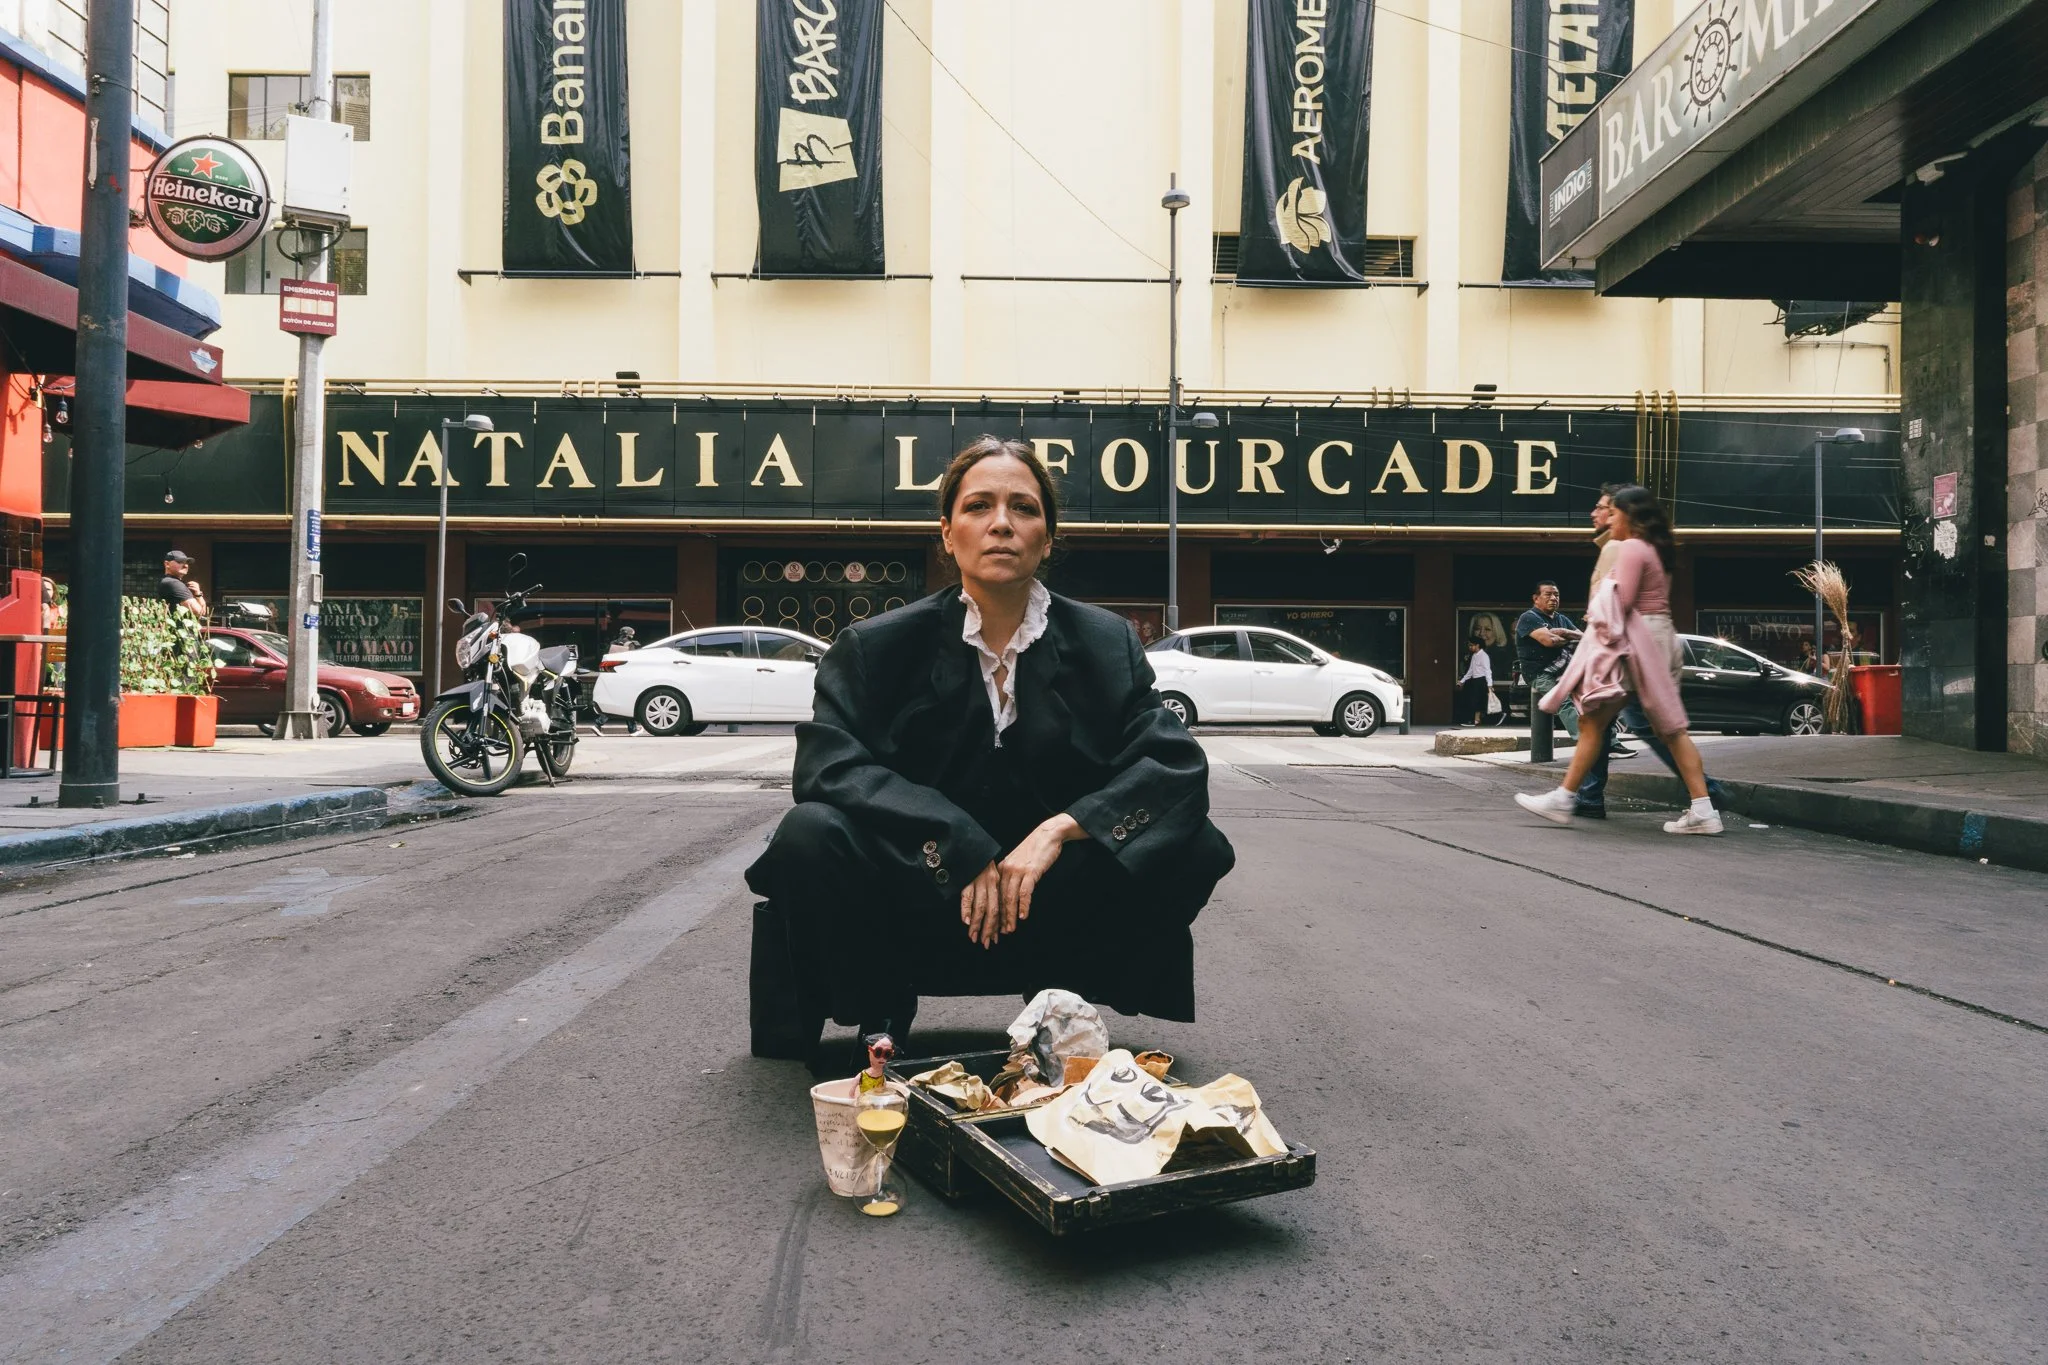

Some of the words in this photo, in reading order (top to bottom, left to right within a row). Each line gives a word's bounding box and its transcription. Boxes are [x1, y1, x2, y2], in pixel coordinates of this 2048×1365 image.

[541, 0, 585, 145] Bana
[1606, 64, 1682, 194] BAR
[153, 177, 255, 214] Heineken
[1554, 170, 1586, 213] INDIO
[283, 285, 335, 297] EMERGENCIAS
[337, 430, 803, 488] NATALIA
[894, 435, 1558, 495] LFOURCADE
[319, 614, 379, 627] ERTAD
[320, 603, 365, 615] ANIA
[361, 640, 414, 655] MAYO
